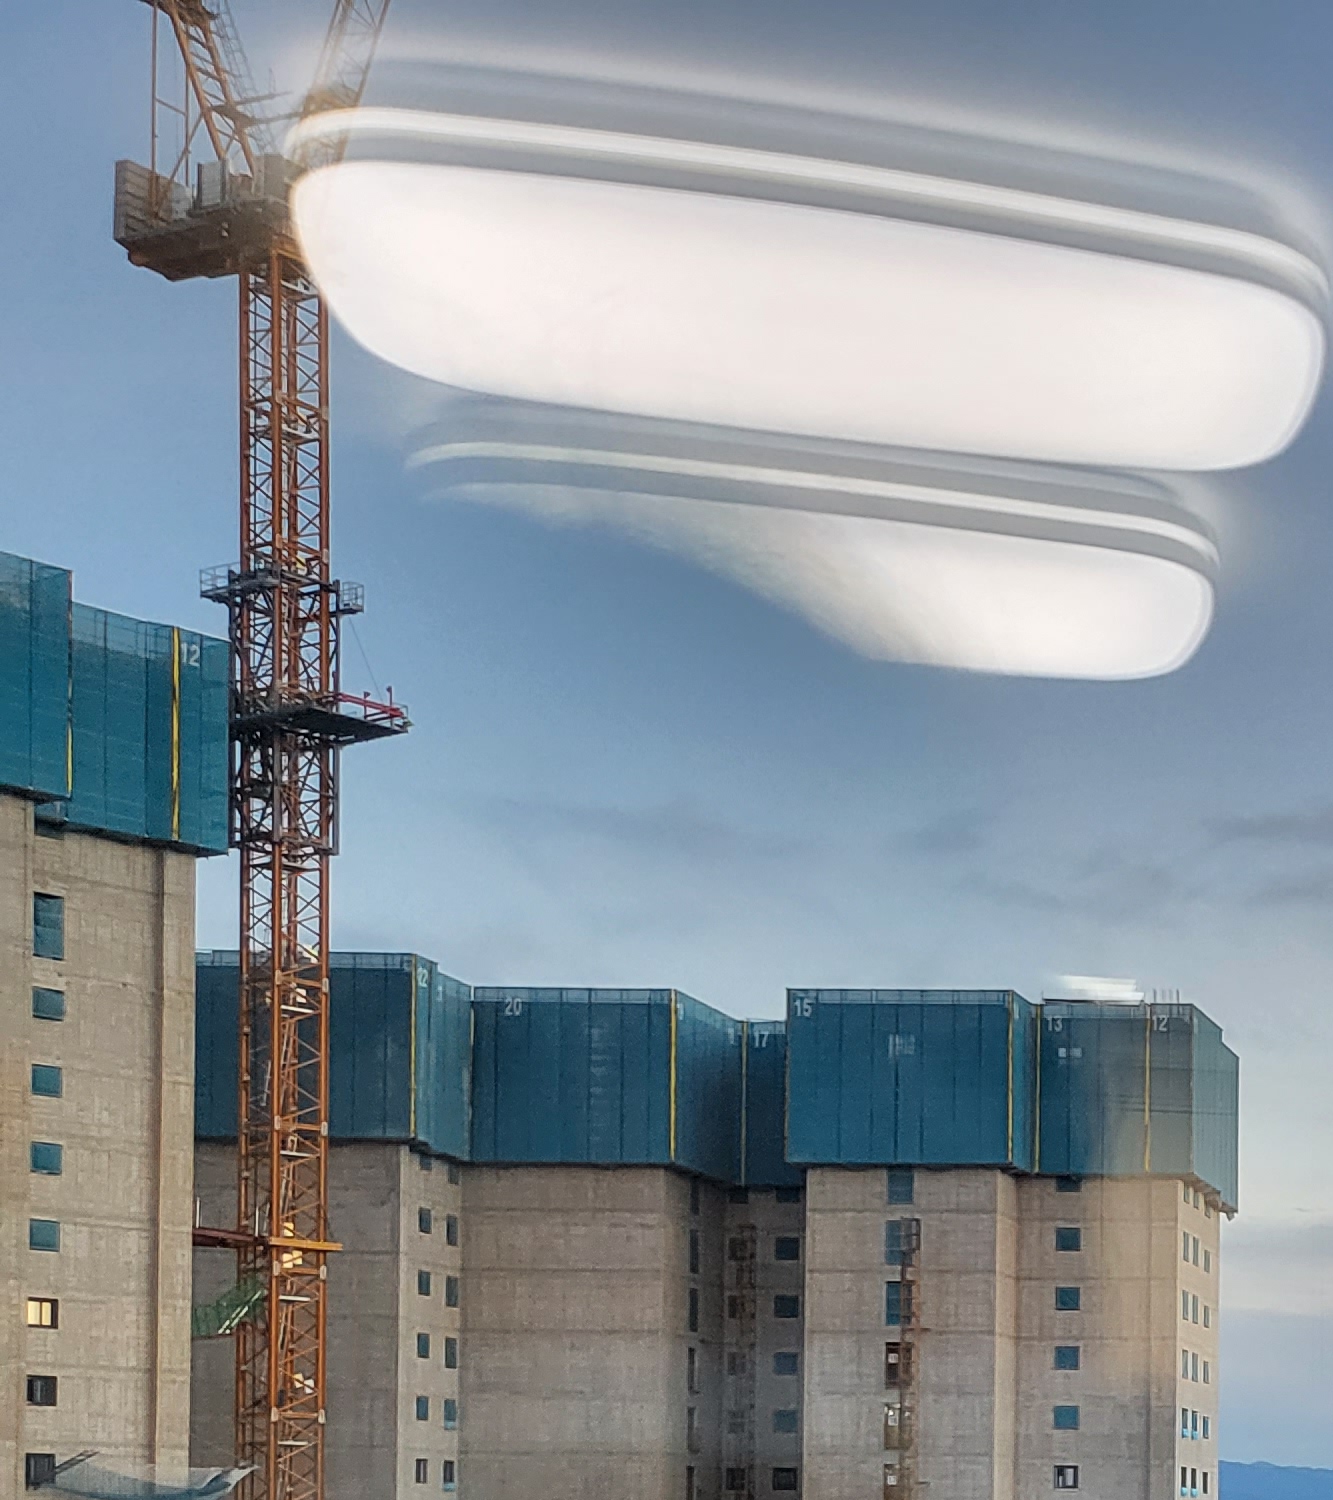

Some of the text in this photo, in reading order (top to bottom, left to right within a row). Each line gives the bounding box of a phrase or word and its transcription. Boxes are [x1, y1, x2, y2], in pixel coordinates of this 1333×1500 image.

[180, 641, 200, 667] 12
[504, 997, 522, 1016] 20
[794, 997, 813, 1018] 15
[1047, 1016, 1062, 1032] 13
[1153, 1015, 1168, 1031] 12
[753, 1030, 769, 1048] 17
